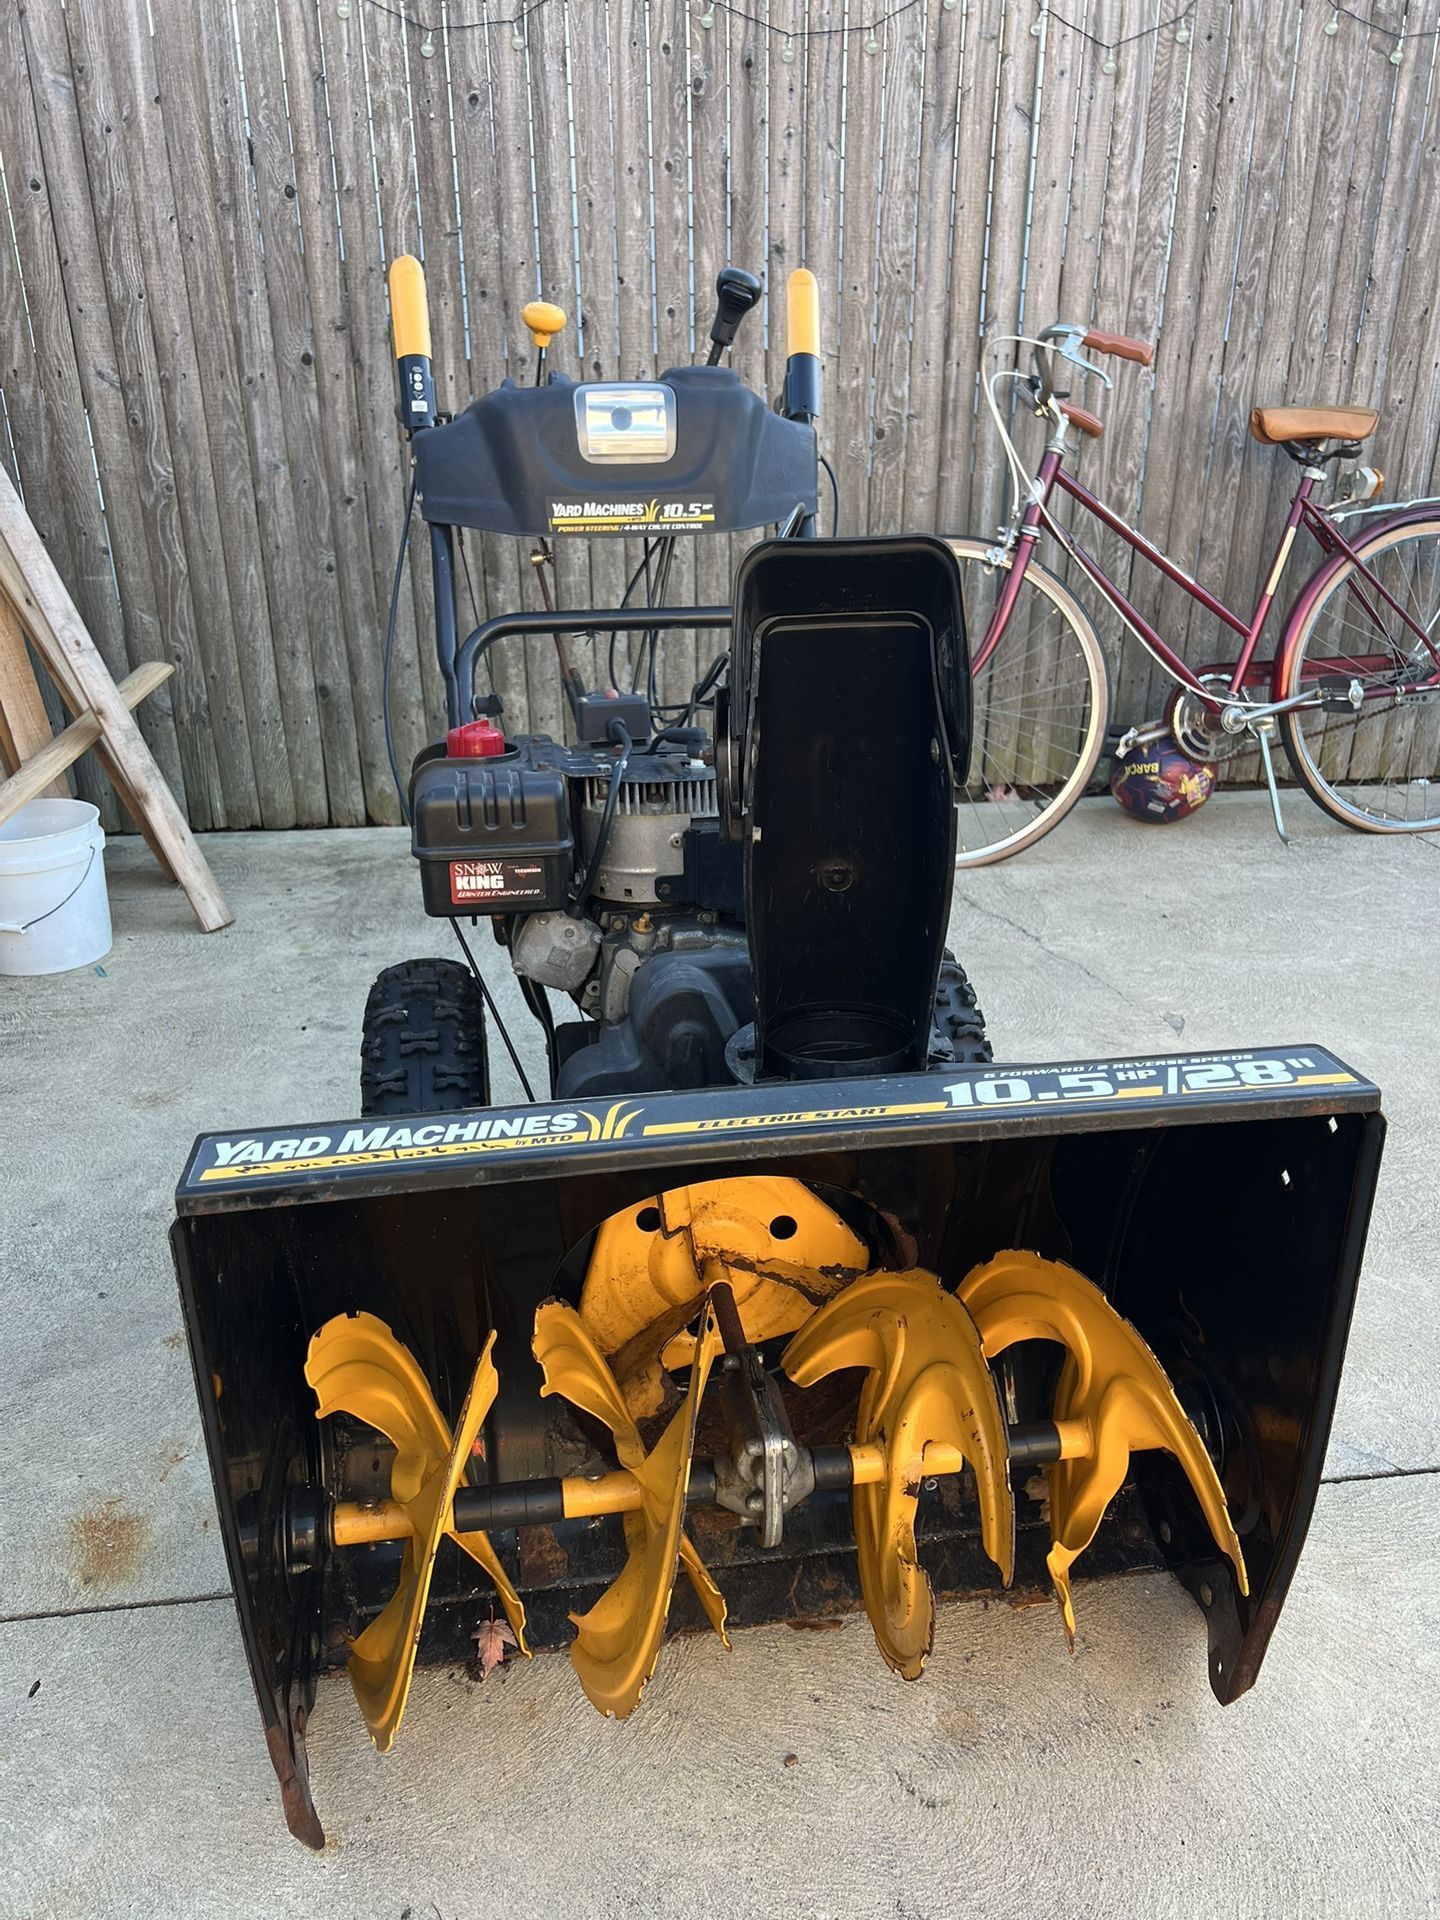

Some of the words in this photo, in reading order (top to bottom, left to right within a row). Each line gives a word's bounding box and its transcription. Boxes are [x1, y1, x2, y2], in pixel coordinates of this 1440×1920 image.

[552, 502, 582, 517] YARD
[583, 502, 644, 516] MACHINES
[663, 503, 702, 518] 10.5
[557, 525, 585, 533] POWER
[456, 875, 504, 890] KING
[491, 889, 541, 897] ENGINEERED
[999, 1066, 1085, 1078] FORWARD
[1112, 1058, 1187, 1069] REVERSE
[1190, 1054, 1254, 1064] SPEEDS
[943, 1074, 1119, 1107] 10.5
[1117, 1068, 1158, 1081] HP
[697, 1114, 810, 1129] ELECTRIC
[812, 1106, 891, 1119] START
[213, 1134, 333, 1168] YARD
[335, 1112, 578, 1155] MACHINES
[515, 1138, 528, 1147] by
[530, 1134, 573, 1144] MTD
